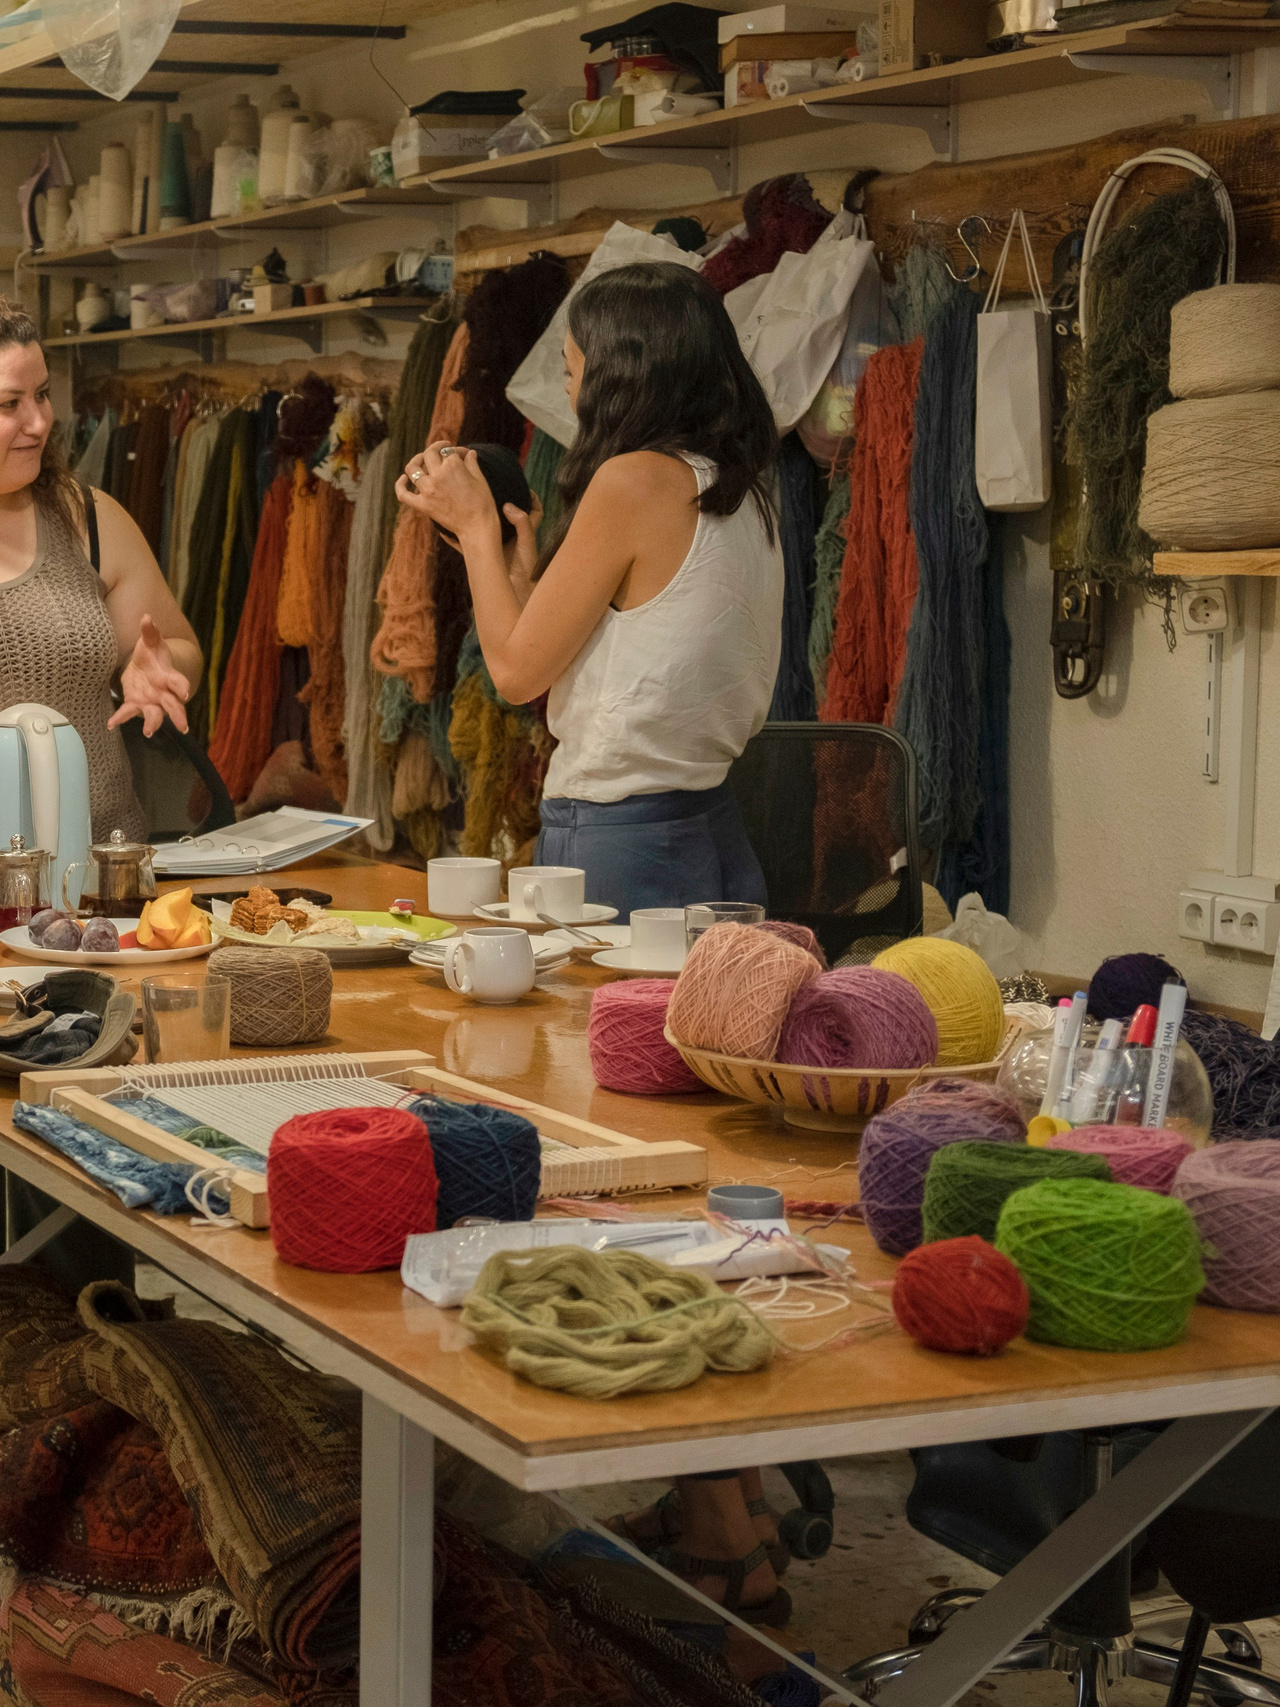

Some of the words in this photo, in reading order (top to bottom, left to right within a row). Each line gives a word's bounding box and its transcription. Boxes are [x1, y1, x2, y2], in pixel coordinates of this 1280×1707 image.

[1160, 1021, 1175, 1054] WHITE
[1154, 1054, 1169, 1091] BOARD
[1147, 1093, 1162, 1128] MARKE
